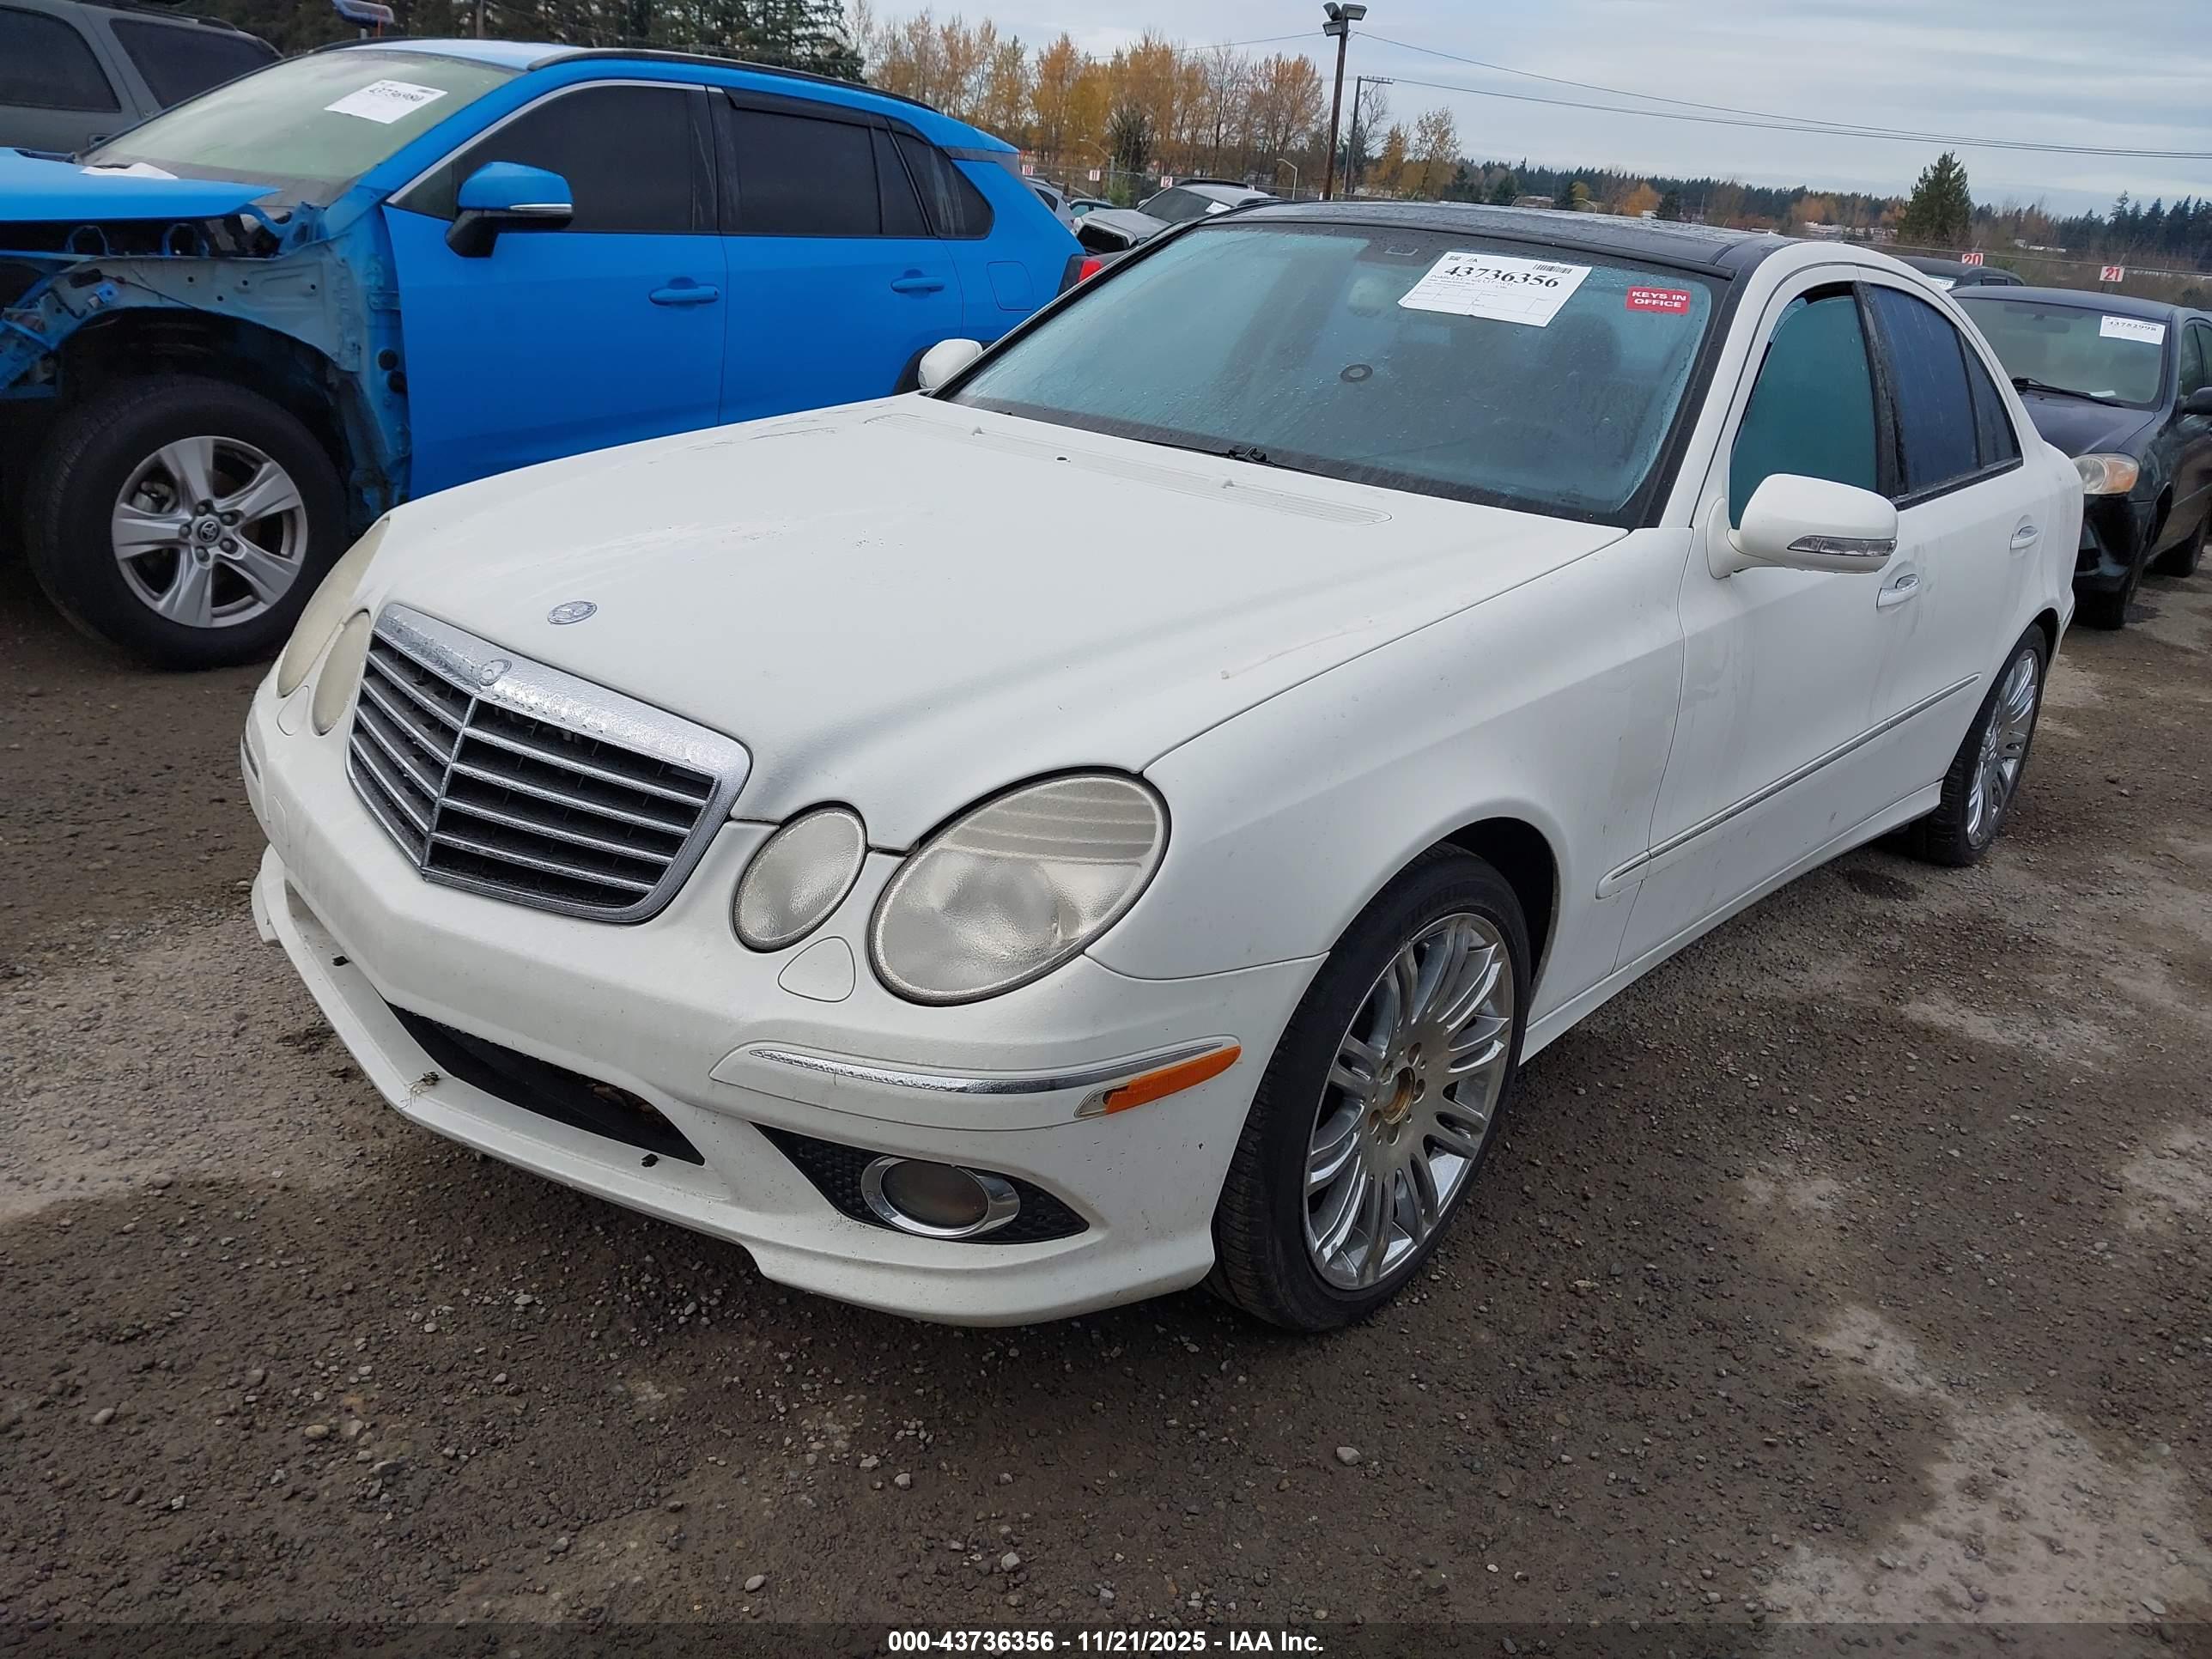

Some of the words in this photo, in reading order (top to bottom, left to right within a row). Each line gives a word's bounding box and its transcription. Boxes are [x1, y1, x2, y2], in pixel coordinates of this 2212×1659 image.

[1964, 253, 1982, 265] 20
[1443, 265, 1562, 288] 43736356
[2104, 267, 2121, 281] 21
[1632, 290, 1668, 300] KEYS
[1634, 298, 1682, 308] OFFICE
